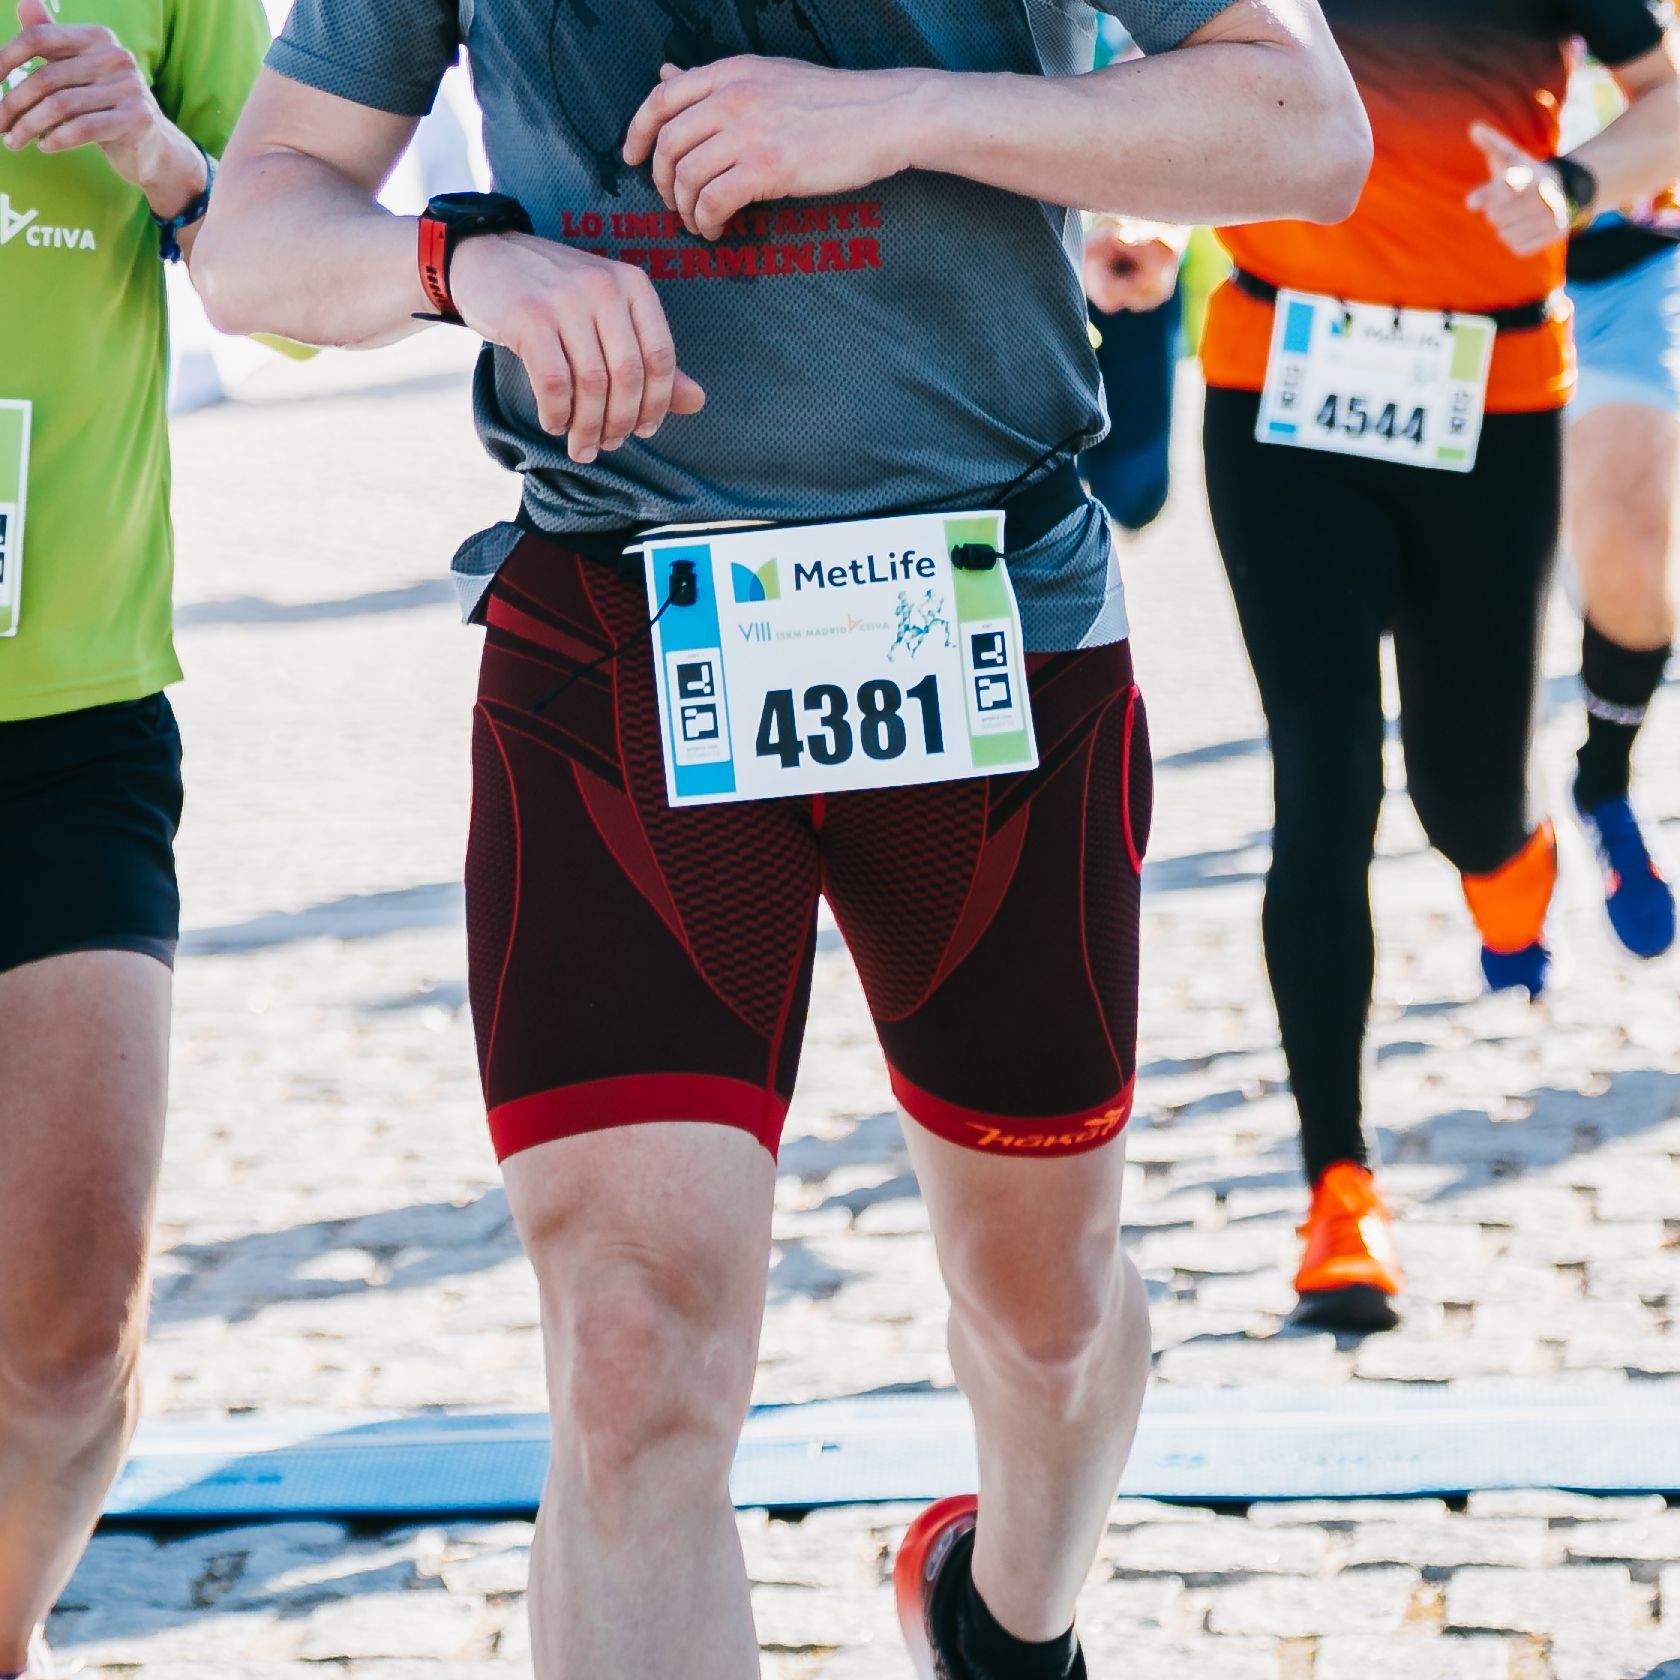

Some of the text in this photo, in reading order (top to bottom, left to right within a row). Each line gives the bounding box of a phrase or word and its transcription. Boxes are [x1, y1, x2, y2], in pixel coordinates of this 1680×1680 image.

[561, 211, 604, 239] LO
[1316, 394, 1426, 446] 4544
[794, 550, 937, 592] MetLife
[738, 622, 772, 642] VIII
[755, 674, 945, 769] 4381
